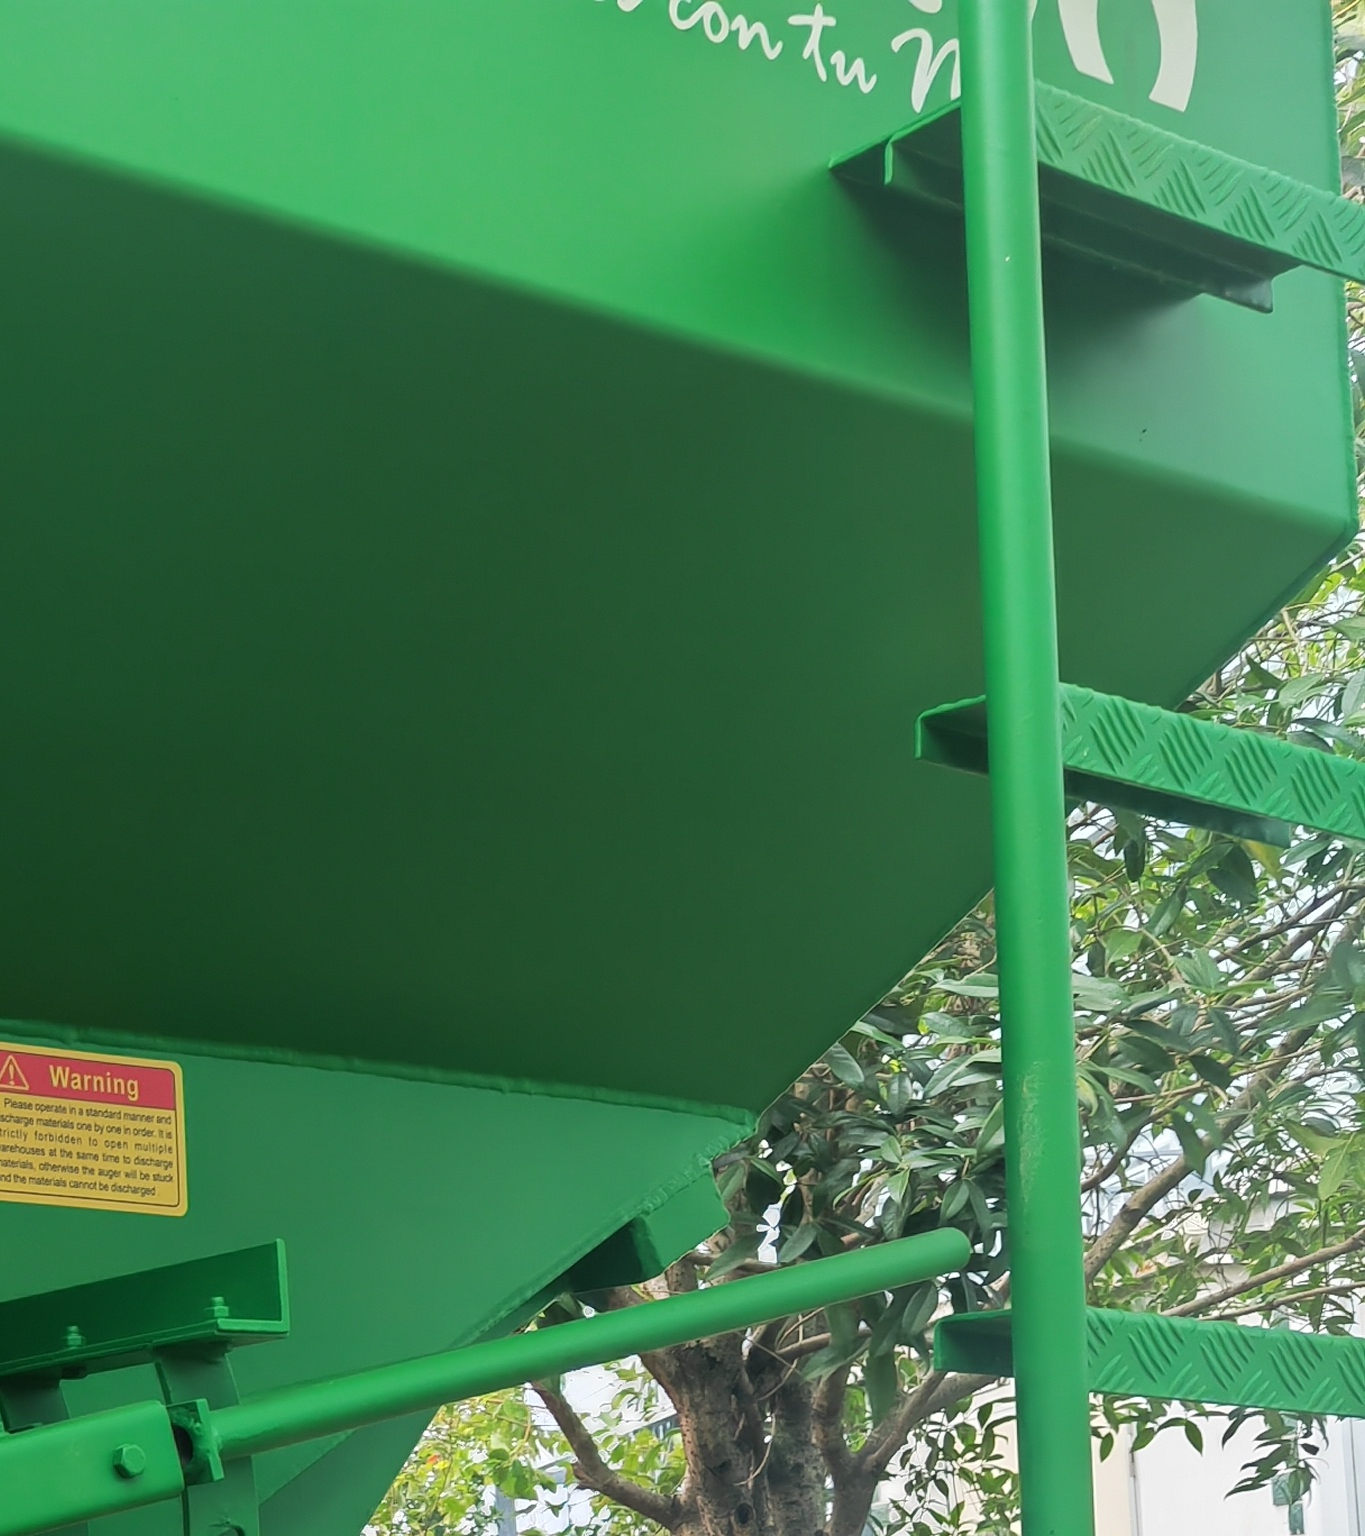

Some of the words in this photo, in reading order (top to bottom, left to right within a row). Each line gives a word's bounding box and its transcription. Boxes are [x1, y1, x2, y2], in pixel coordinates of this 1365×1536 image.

[669, 0, 783, 60] con
[788, 3, 877, 94] tu
[49, 1064, 140, 1102] Warning
[4, 1098, 33, 1110] Please
[35, 1103, 67, 1114] operate
[70, 1105, 76, 1115] in
[78, 1108, 84, 1116] a
[86, 1108, 122, 1120] standard
[123, 1112, 155, 1123] manner
[156, 1115, 172, 1125] and
[36, 1118, 74, 1129] materials
[76, 1122, 92, 1131] one
[94, 1122, 104, 1135] by
[106, 1125, 122, 1134] one
[124, 1125, 131, 1135] in
[133, 1127, 156, 1138] order.
[166, 1130, 172, 1139] is
[34, 1130, 82, 1145] forbidden
[89, 1136, 98, 1147] to
[104, 1139, 128, 1150] open
[134, 1142, 173, 1155] multiple
[49, 1148, 57, 1157] at
[60, 1148, 73, 1159] the
[76, 1151, 99, 1162] same
[102, 1153, 119, 1163] time
[123, 1155, 131, 1164] to
[134, 1156, 173, 1170] discharge
[13, 1174, 26, 1184] the
[29, 1176, 67, 1188] materials
[69, 1179, 97, 1190] cannot
[98, 1181, 109, 1191] be
[39, 1162, 79, 1174] otherwise
[82, 1166, 95, 1175] the
[98, 1168, 121, 1180] auger
[124, 1169, 137, 1179] will
[140, 1171, 150, 1181] be
[152, 1173, 173, 1182] stuck
